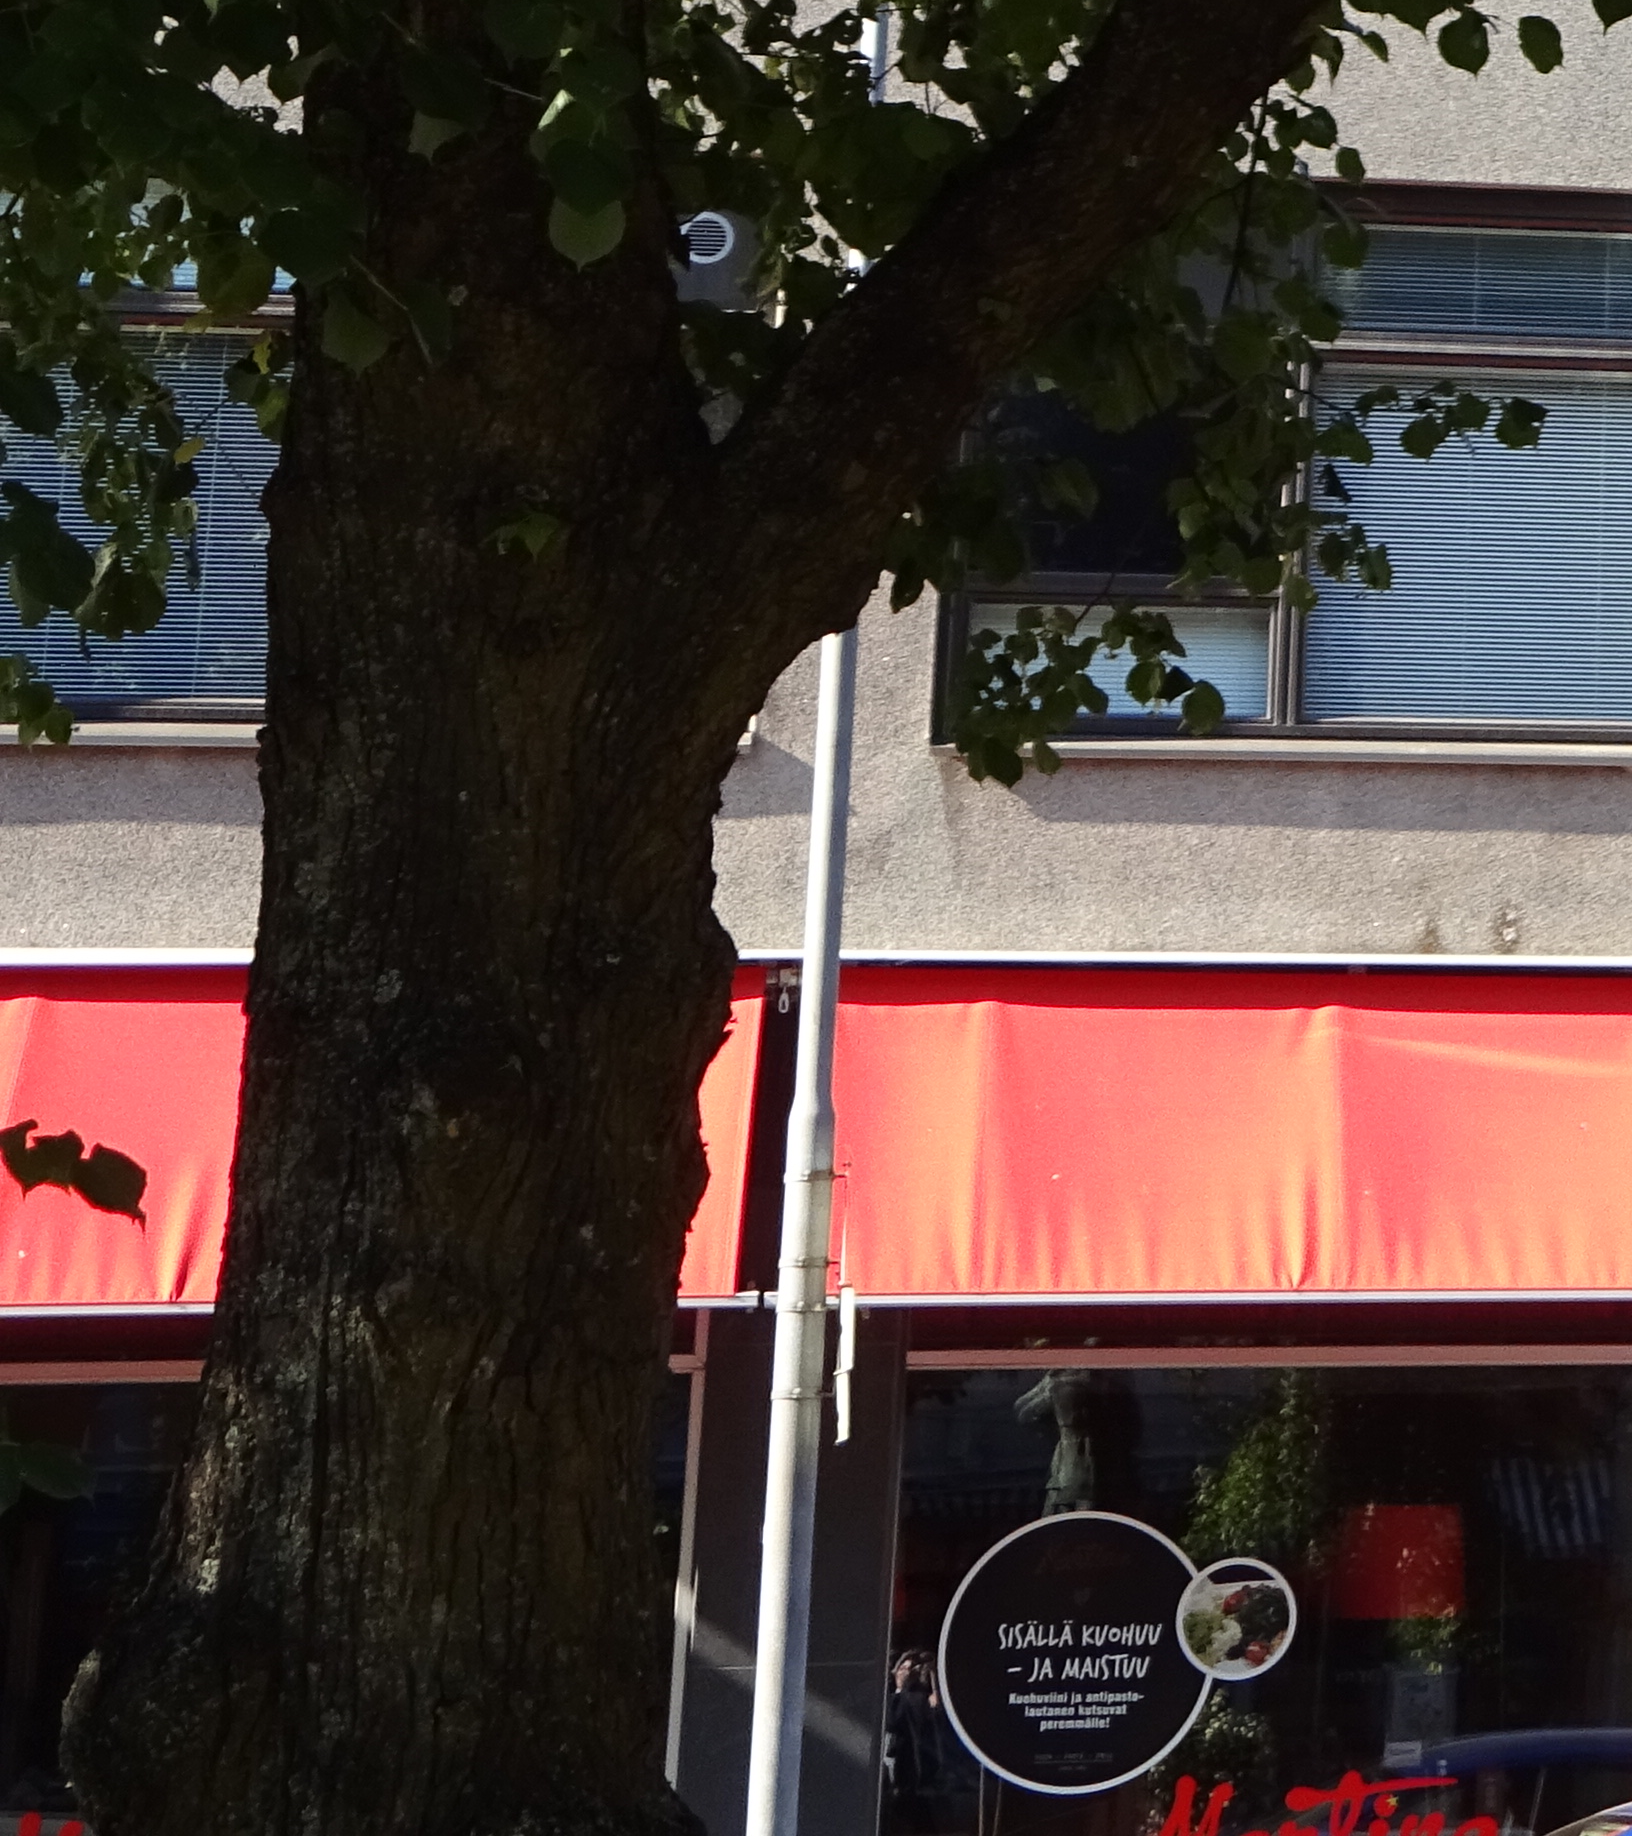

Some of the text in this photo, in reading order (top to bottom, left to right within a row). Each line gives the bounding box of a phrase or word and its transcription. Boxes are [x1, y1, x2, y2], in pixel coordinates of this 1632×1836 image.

[997, 1619, 1163, 1650] SISÄLLÄ KUOHUU
[1027, 1656, 1054, 1683] JA
[1061, 1653, 1151, 1682] MAISTUU
[1008, 1692, 1068, 1705] Kuohuviini
[1070, 1691, 1082, 1705] ja
[1024, 1704, 1128, 1718] lautanen kutsuvat
[1039, 1717, 1111, 1733] peremmälle!
